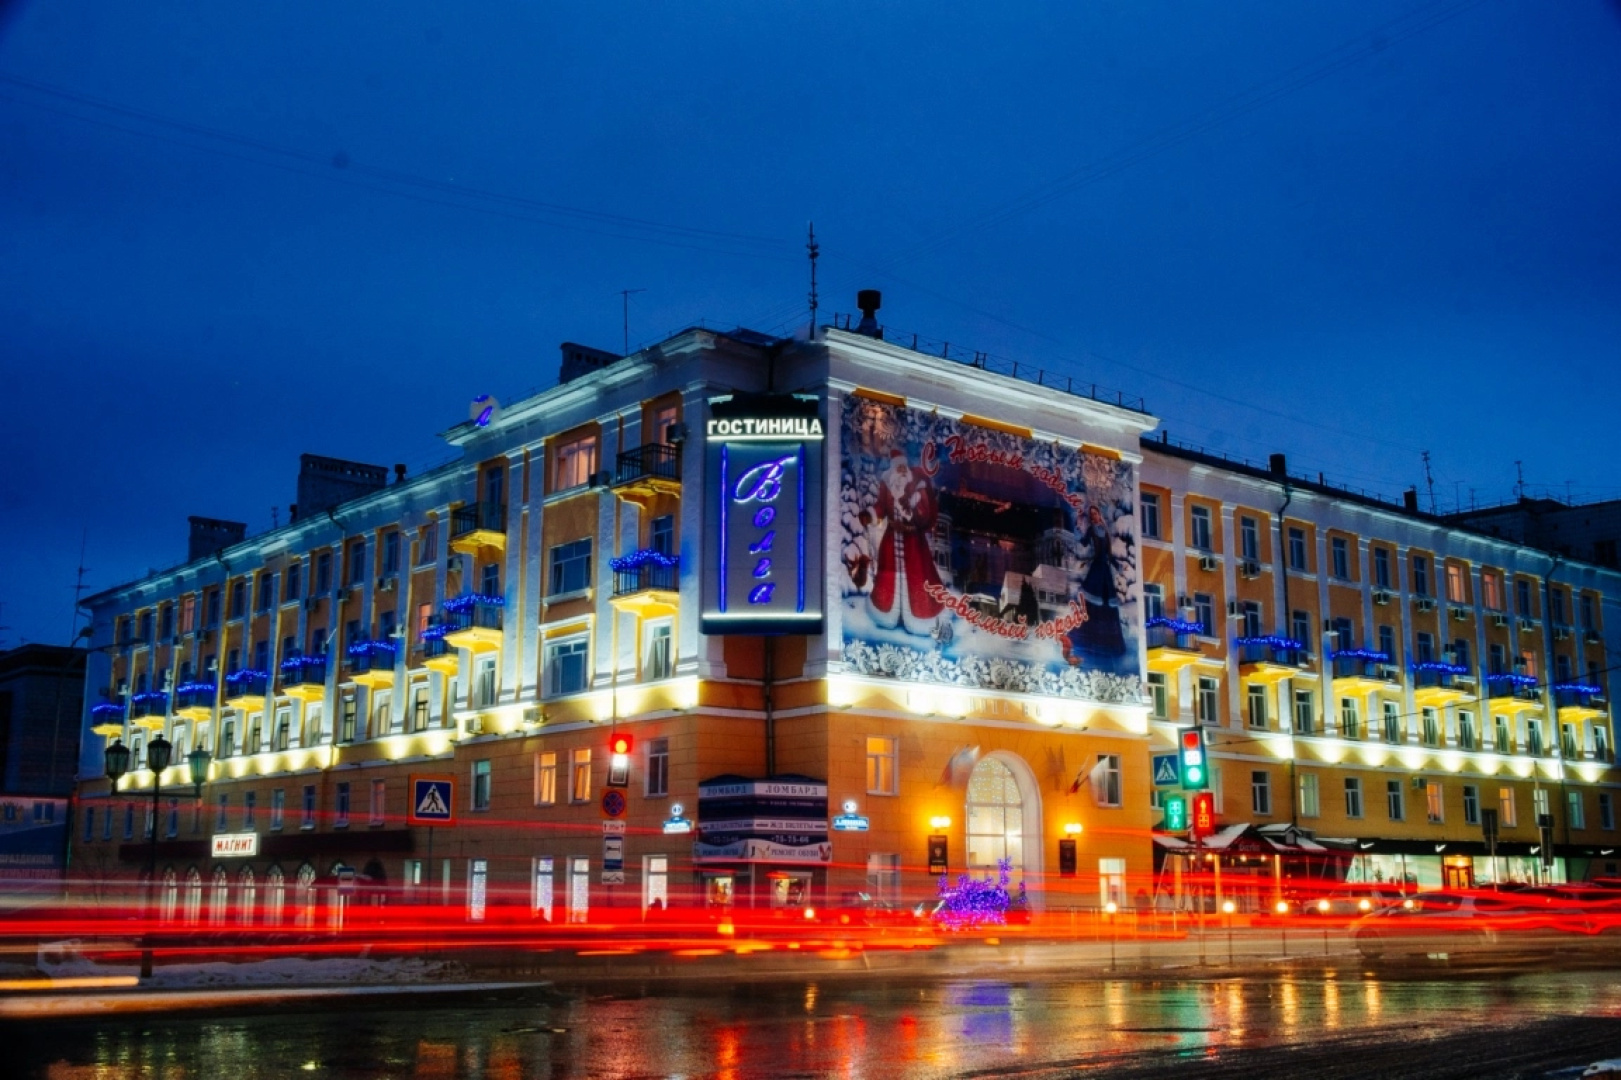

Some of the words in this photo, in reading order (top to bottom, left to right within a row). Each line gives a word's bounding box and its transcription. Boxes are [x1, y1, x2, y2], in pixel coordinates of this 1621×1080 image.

[707, 419, 823, 436] ГОСТИНИЦА
[921, 441, 940, 477] С
[945, 435, 1024, 470] Новым
[732, 455, 798, 605] Волга
[1034, 592, 1089, 642] город!
[765, 784, 818, 796] ЛОМБАРД
[214, 838, 253, 852] МАГНИТ
[771, 848, 797, 857] РЕМОНТ
